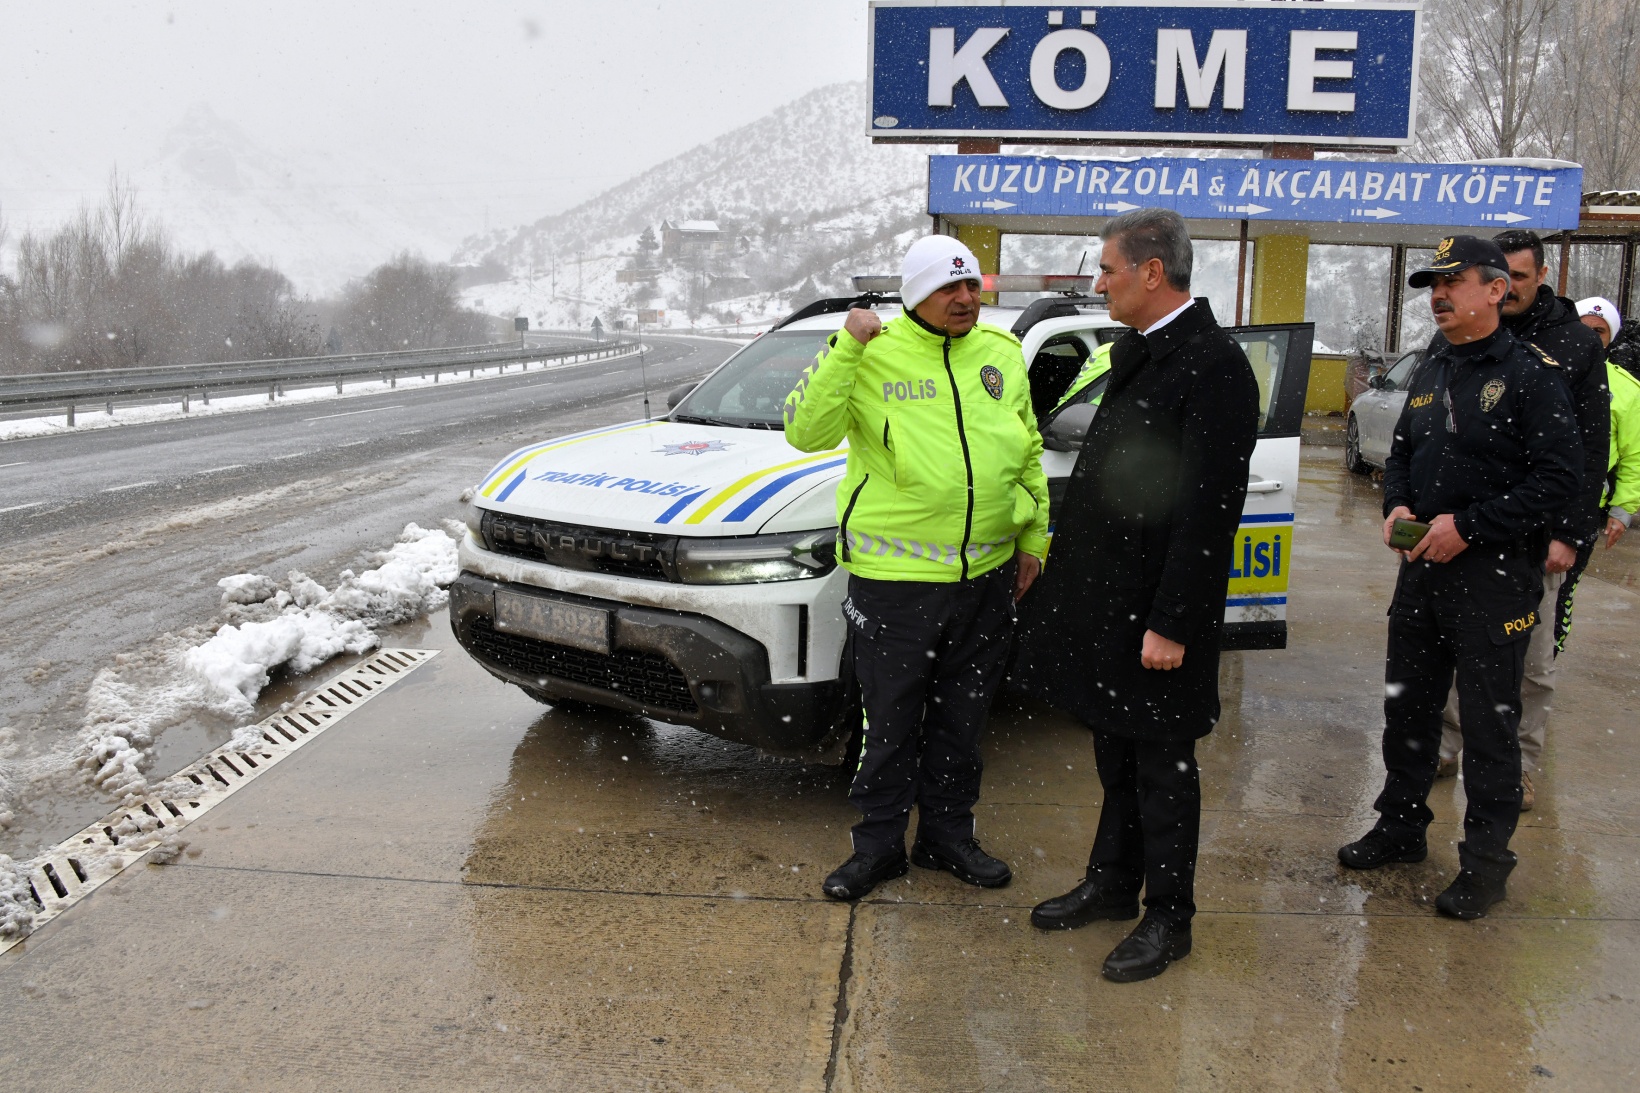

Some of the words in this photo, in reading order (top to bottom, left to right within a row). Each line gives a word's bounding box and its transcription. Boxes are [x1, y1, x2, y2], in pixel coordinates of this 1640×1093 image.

[927, 10, 1359, 112] KÖME
[953, 164, 1047, 194] KUZU
[1053, 160, 1199, 197] PİRZOLA
[1208, 175, 1226, 197] &
[1238, 168, 1431, 206] AKÇAABAT
[1436, 167, 1557, 206] KÖFTE
[532, 471, 618, 488] TRAFİK
[493, 523, 653, 562] RENAULT
